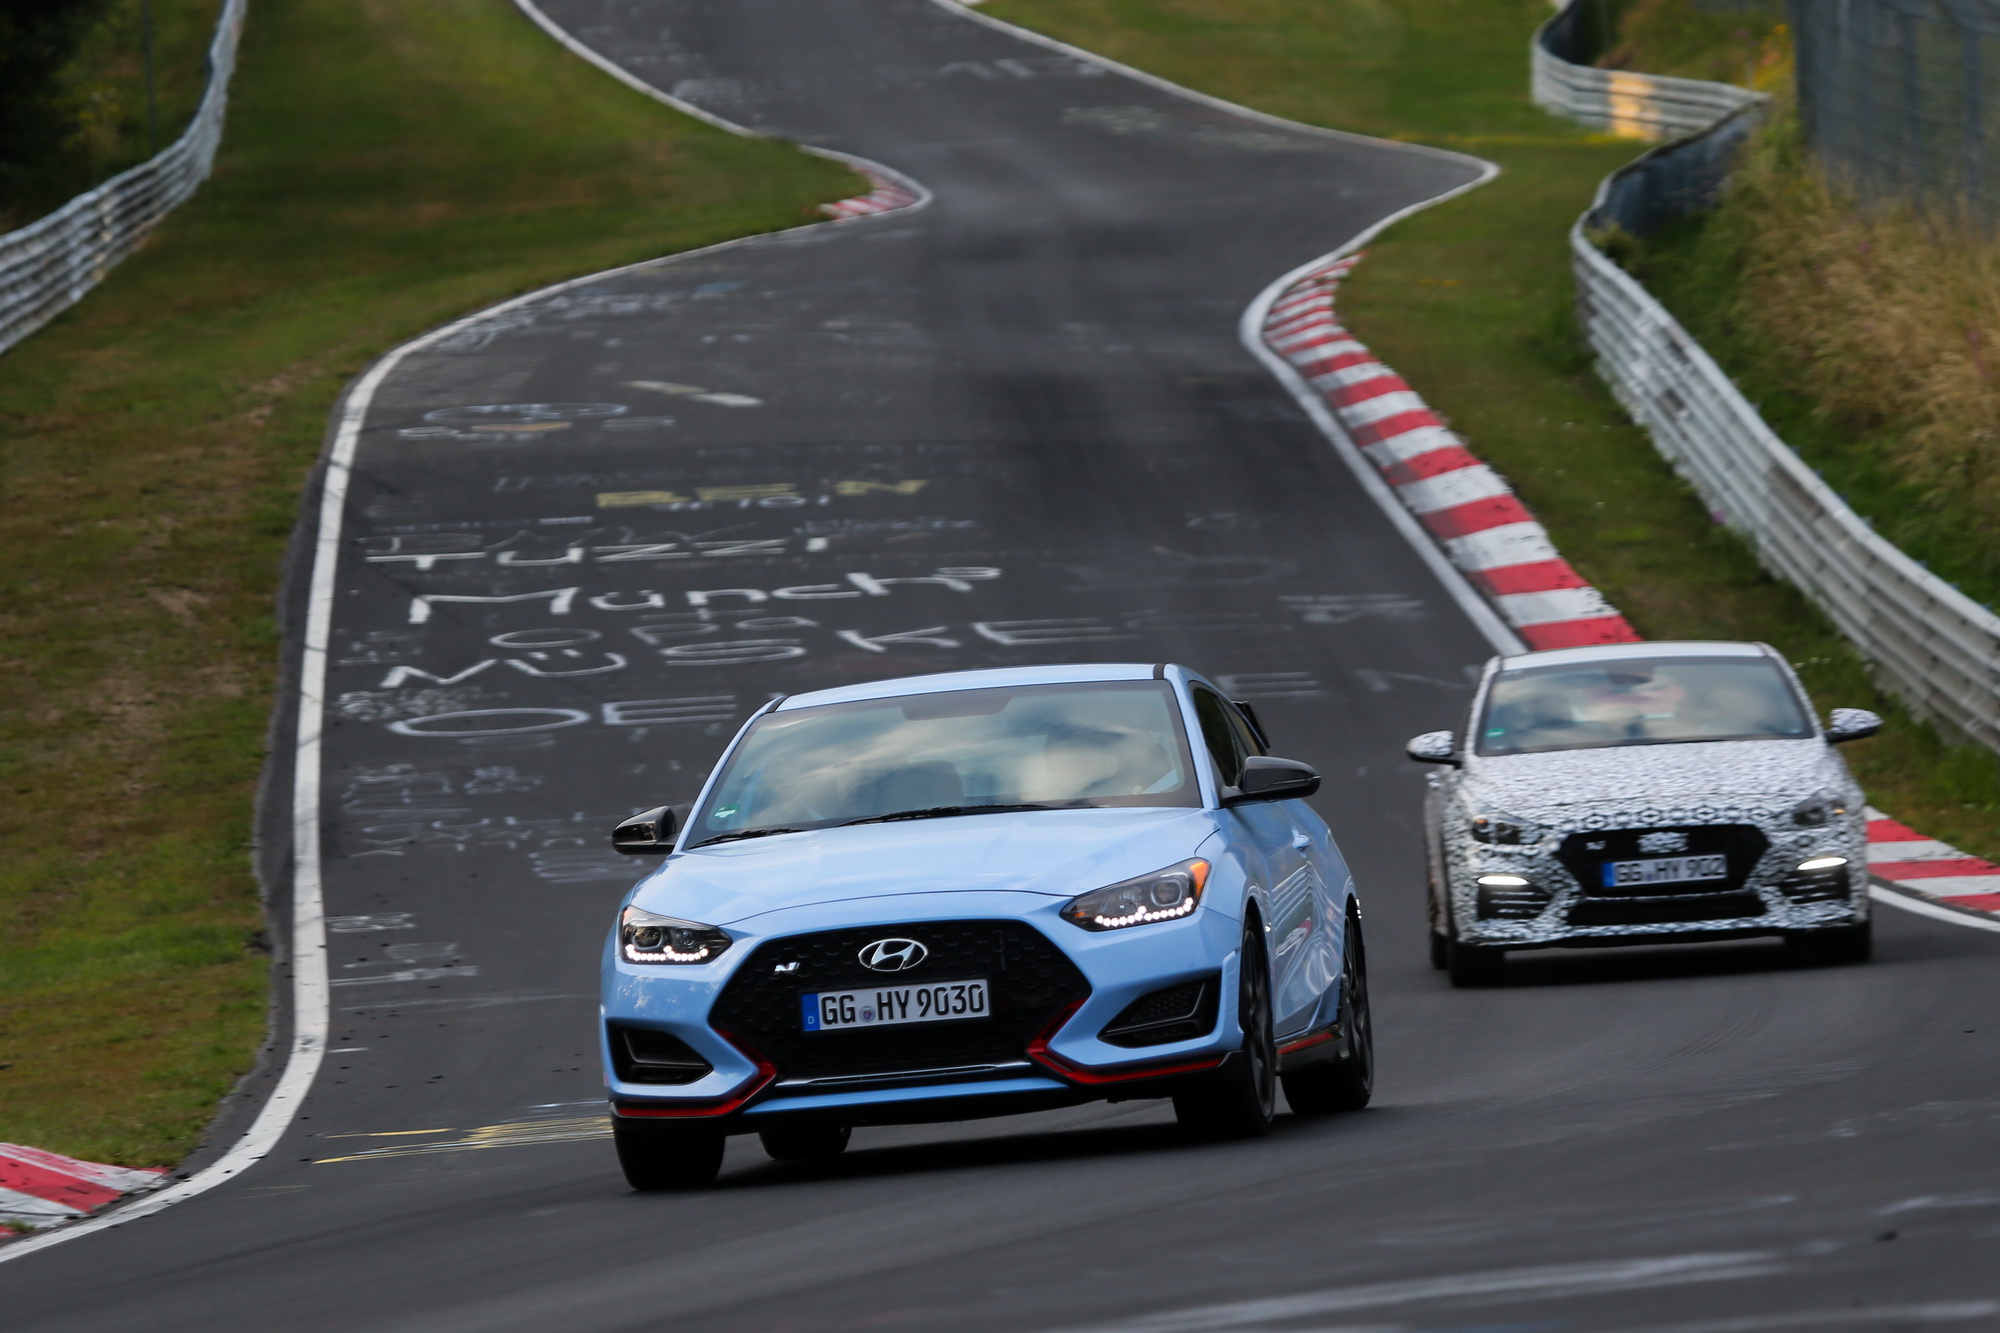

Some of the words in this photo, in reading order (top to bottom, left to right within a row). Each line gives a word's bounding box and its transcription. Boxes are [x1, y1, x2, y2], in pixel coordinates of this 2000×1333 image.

[820, 994, 856, 1026] GG
[876, 988, 910, 1021] HY
[916, 983, 985, 1017] 9030
[807, 1015, 815, 1025] D
